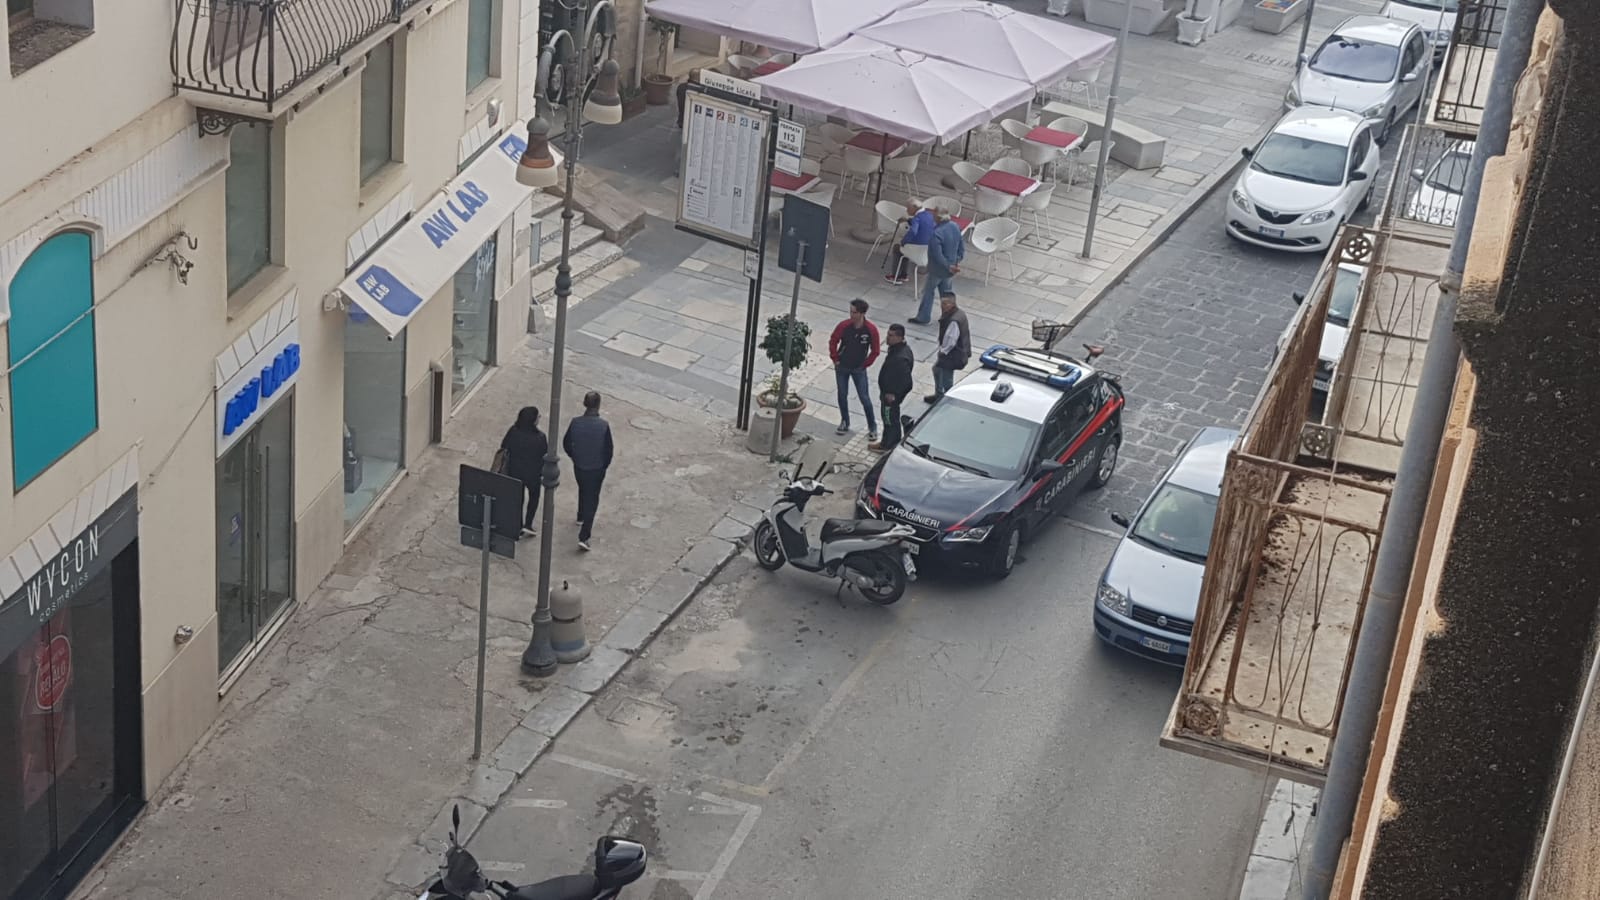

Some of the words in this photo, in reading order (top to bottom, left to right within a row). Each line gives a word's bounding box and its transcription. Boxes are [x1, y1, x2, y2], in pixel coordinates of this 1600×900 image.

[704, 77, 735, 91] Giuseppe
[783, 132, 796, 143] 113
[421, 208, 459, 249] AW
[447, 181, 489, 223] LAB
[363, 274, 378, 292] AW
[372, 284, 390, 301] LAB
[1043, 447, 1096, 504] CARABINIERI
[886, 505, 940, 528] CARABINIERI
[27, 525, 99, 617] WYCON
[40, 571, 88, 622] cosmetics
